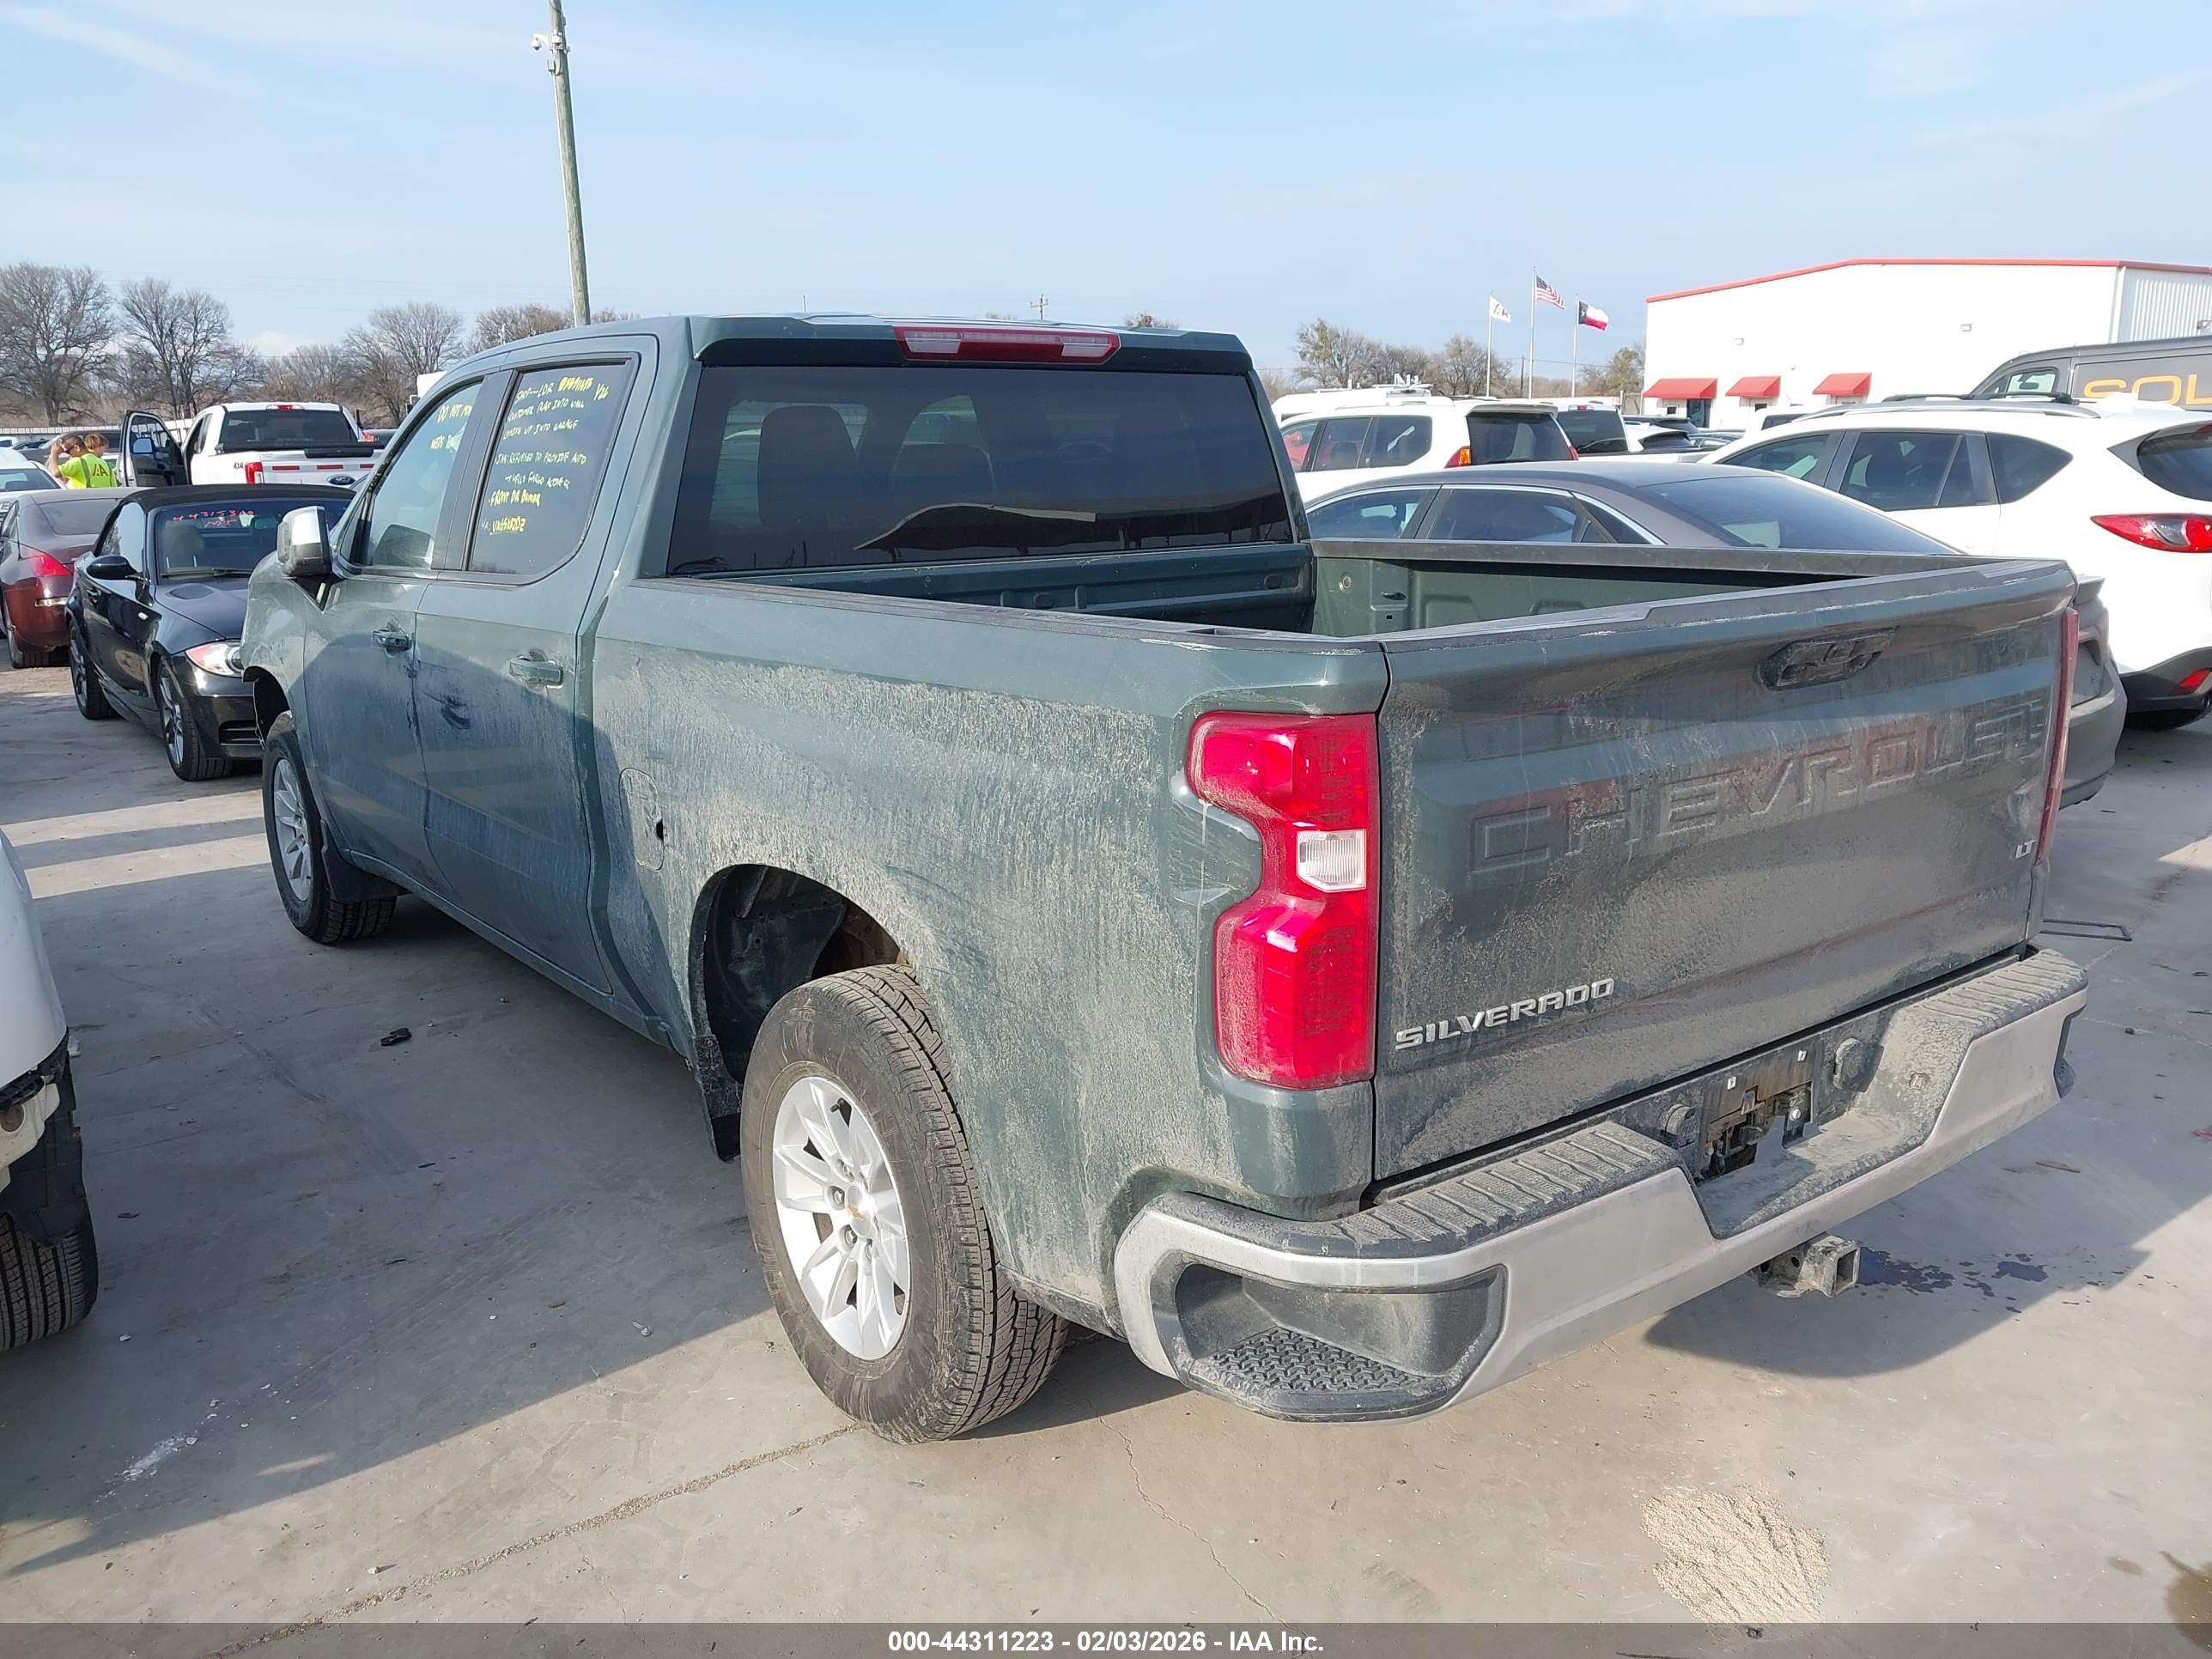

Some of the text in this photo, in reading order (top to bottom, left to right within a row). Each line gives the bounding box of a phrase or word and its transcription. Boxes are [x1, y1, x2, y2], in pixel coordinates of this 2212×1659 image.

[1470, 695, 2047, 872] CHEVROLET
[2015, 839, 2036, 859] LT
[1395, 977, 1615, 1050] SILVERADO
